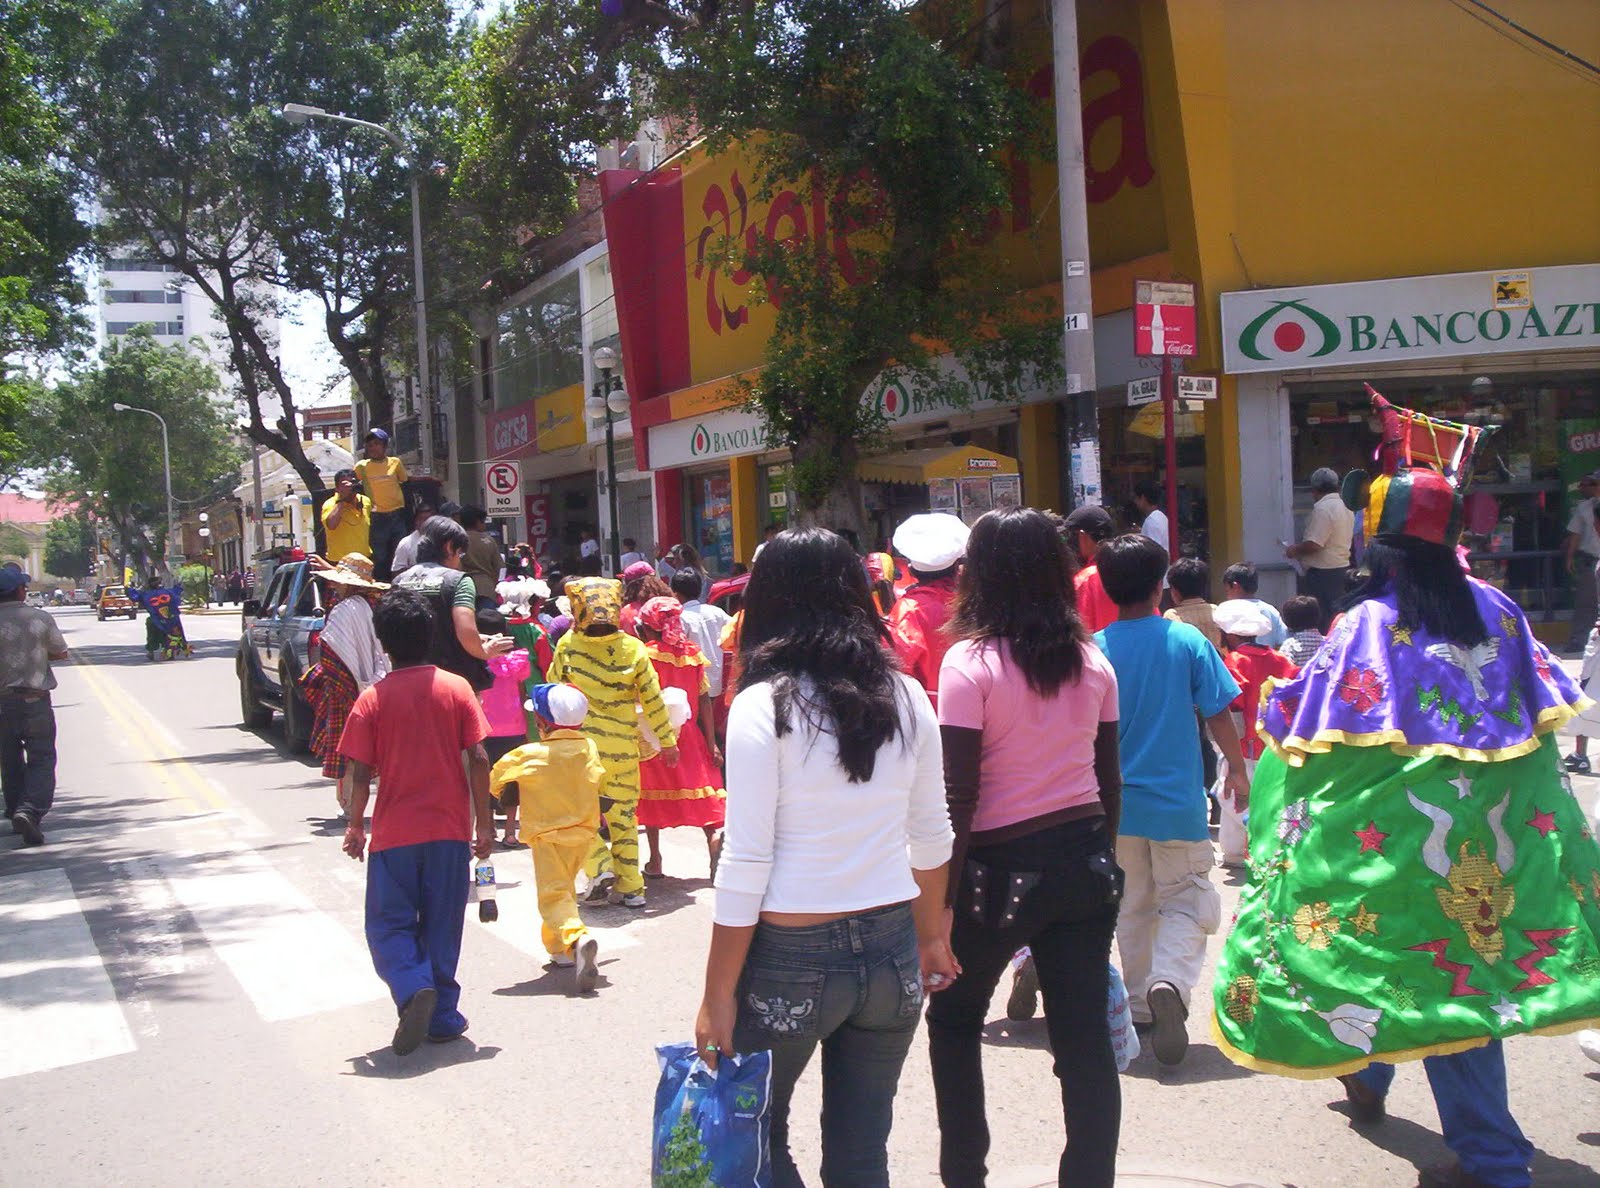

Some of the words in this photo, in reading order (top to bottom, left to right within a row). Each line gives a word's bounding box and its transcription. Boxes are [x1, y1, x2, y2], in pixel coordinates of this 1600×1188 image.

[1347, 309, 1511, 352] BANCO
[1141, 379, 1158, 395] GRAU
[494, 414, 528, 450] carsa
[713, 429, 749, 453] BANCO
